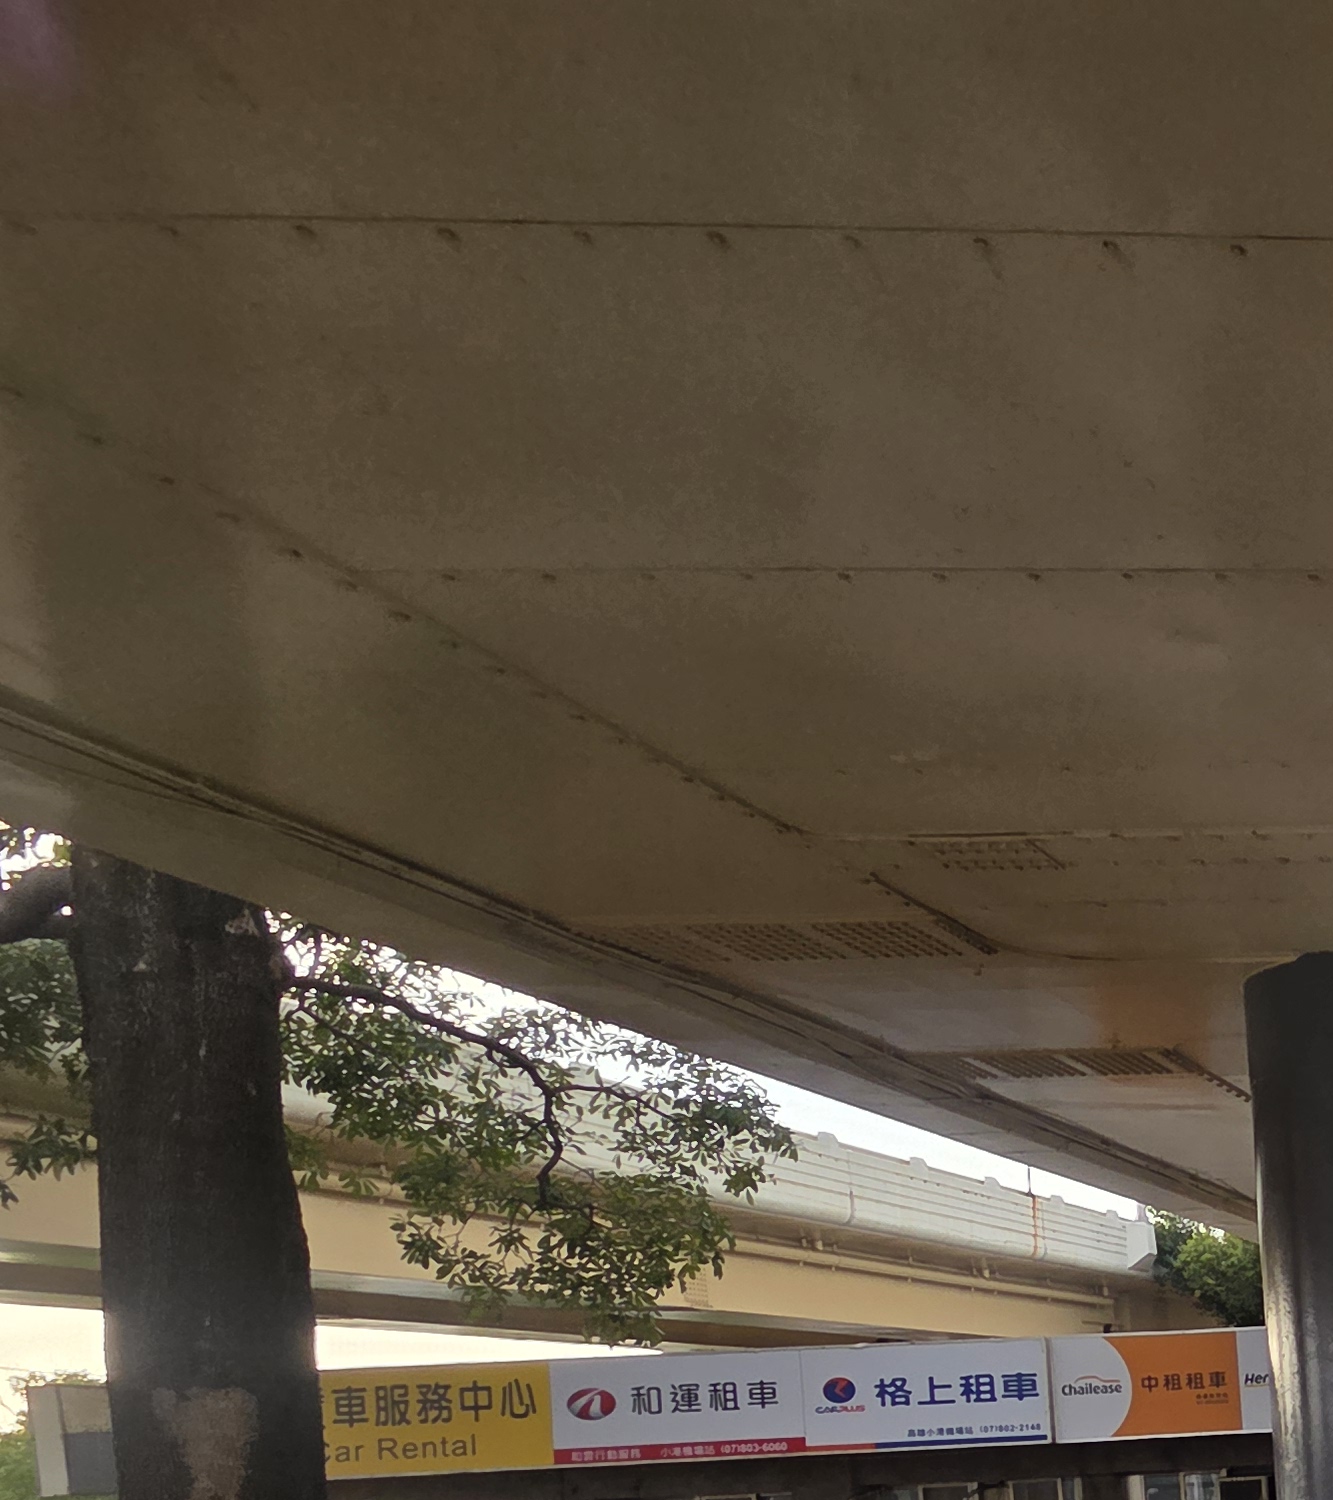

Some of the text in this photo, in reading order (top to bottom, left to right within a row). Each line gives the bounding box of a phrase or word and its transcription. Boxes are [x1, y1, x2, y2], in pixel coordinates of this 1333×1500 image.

[874, 1372, 1039, 1407] 格上租車
[1061, 1382, 1122, 1397] Chailease
[1141, 1371, 1228, 1392] 中租租車
[1244, 1373, 1269, 1386] Her
[321, 1378, 537, 1428] 車服務中心
[630, 1380, 779, 1415] 和運租車
[377, 1434, 478, 1461] Rental
